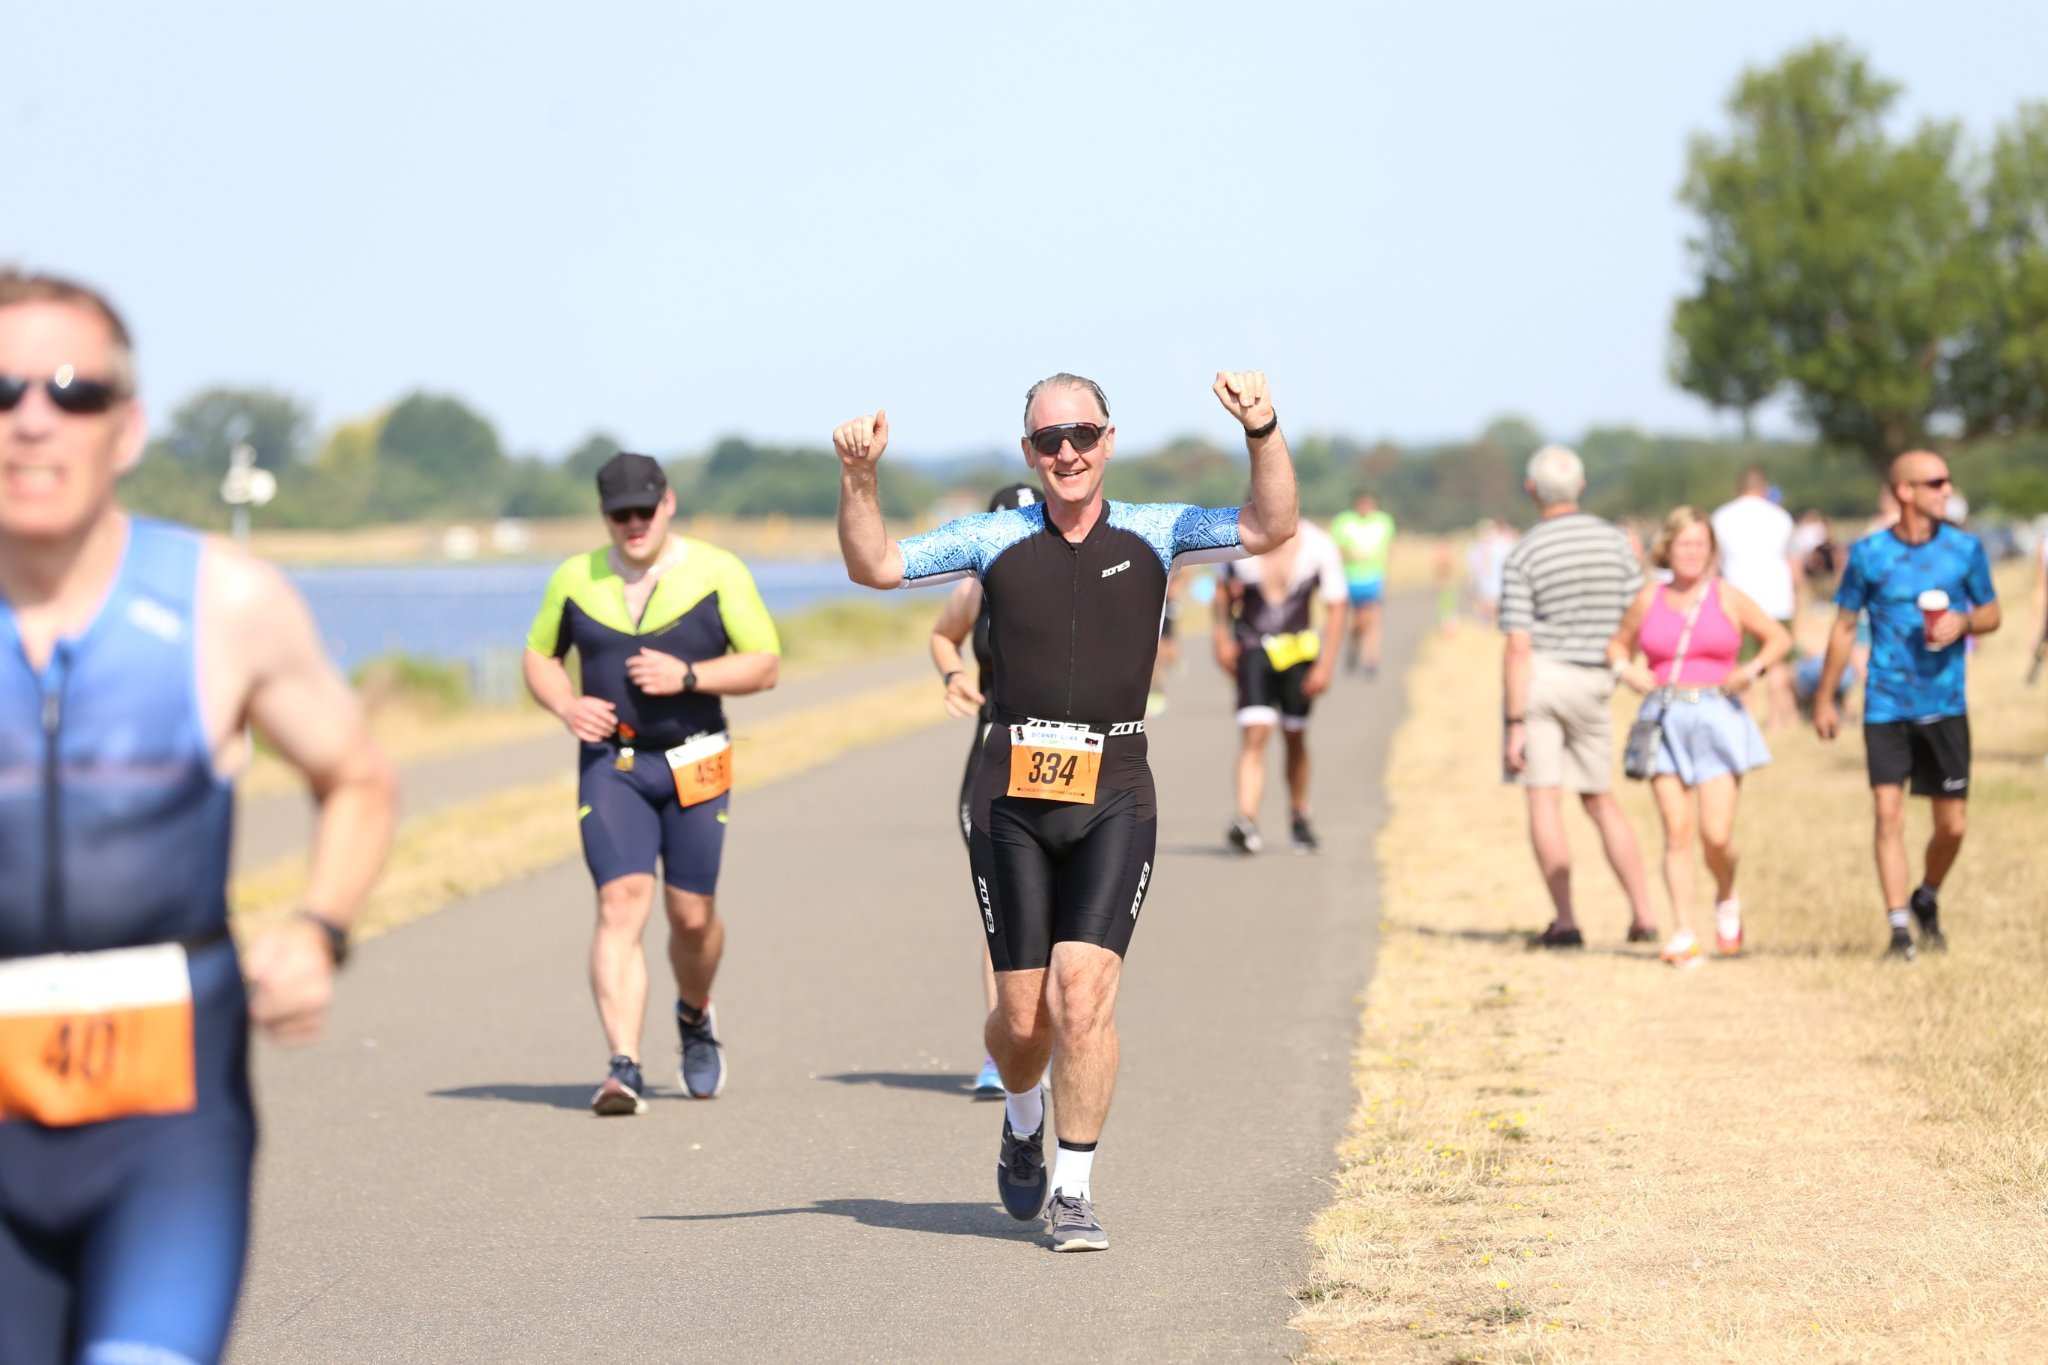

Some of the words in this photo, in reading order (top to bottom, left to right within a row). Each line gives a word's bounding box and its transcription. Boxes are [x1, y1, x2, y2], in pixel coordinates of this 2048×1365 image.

[1028, 751, 1078, 786] 334
[978, 876, 995, 933] ZONE3
[1130, 861, 1150, 919] ZONE3
